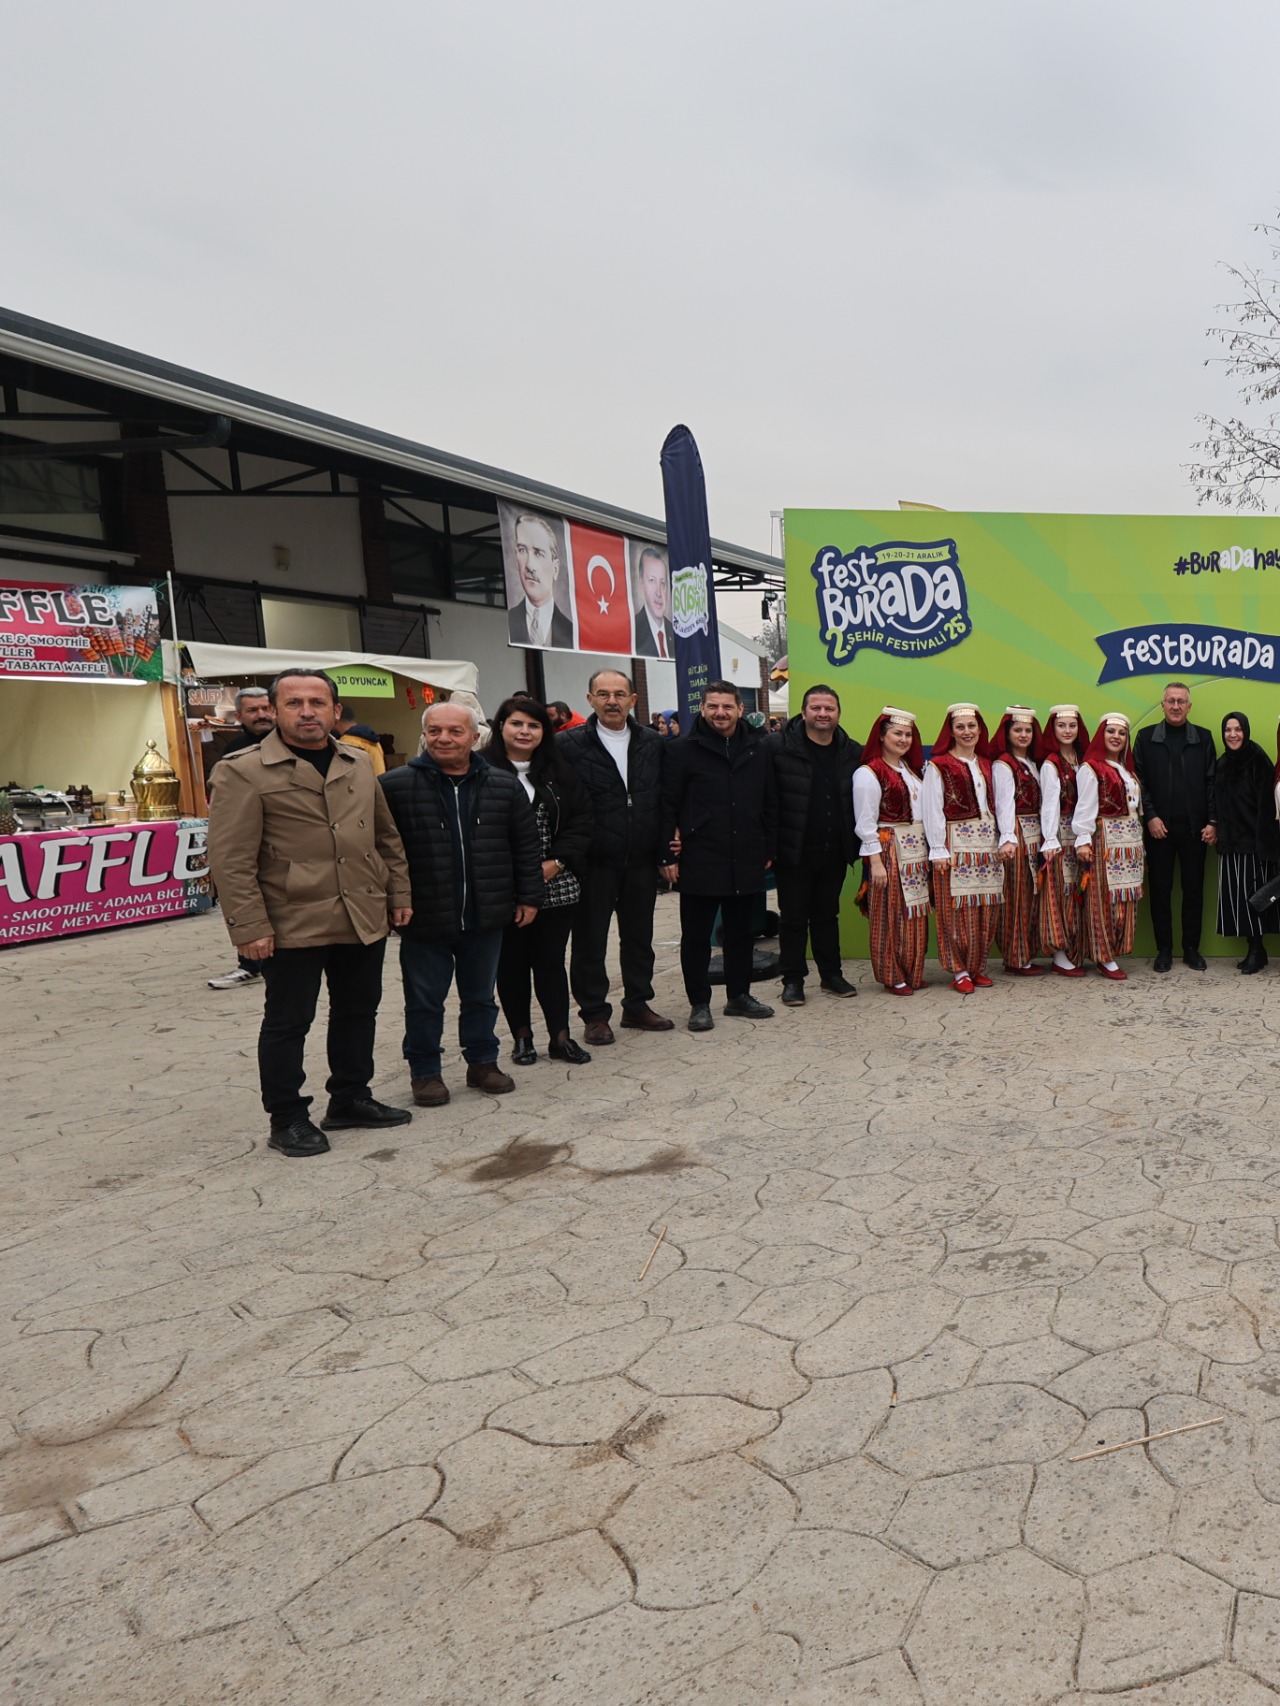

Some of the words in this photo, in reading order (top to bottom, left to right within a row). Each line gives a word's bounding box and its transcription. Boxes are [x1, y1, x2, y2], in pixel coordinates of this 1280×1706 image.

[881, 552, 914, 560] 19-20-21
[917, 552, 944, 560] ARALIK
[847, 629, 885, 646] ŞEHİR
[886, 632, 947, 651] FESTİVALİ
[6, 660, 62, 672] TABAKTA
[63, 663, 107, 674] WAFFLE
[336, 675, 348, 685] 3D
[349, 676, 388, 687] OYUNCAK
[103, 893, 153, 909] ADANA
[62, 911, 112, 929] MEYVE
[115, 898, 198, 920] KOKTEYLLER
